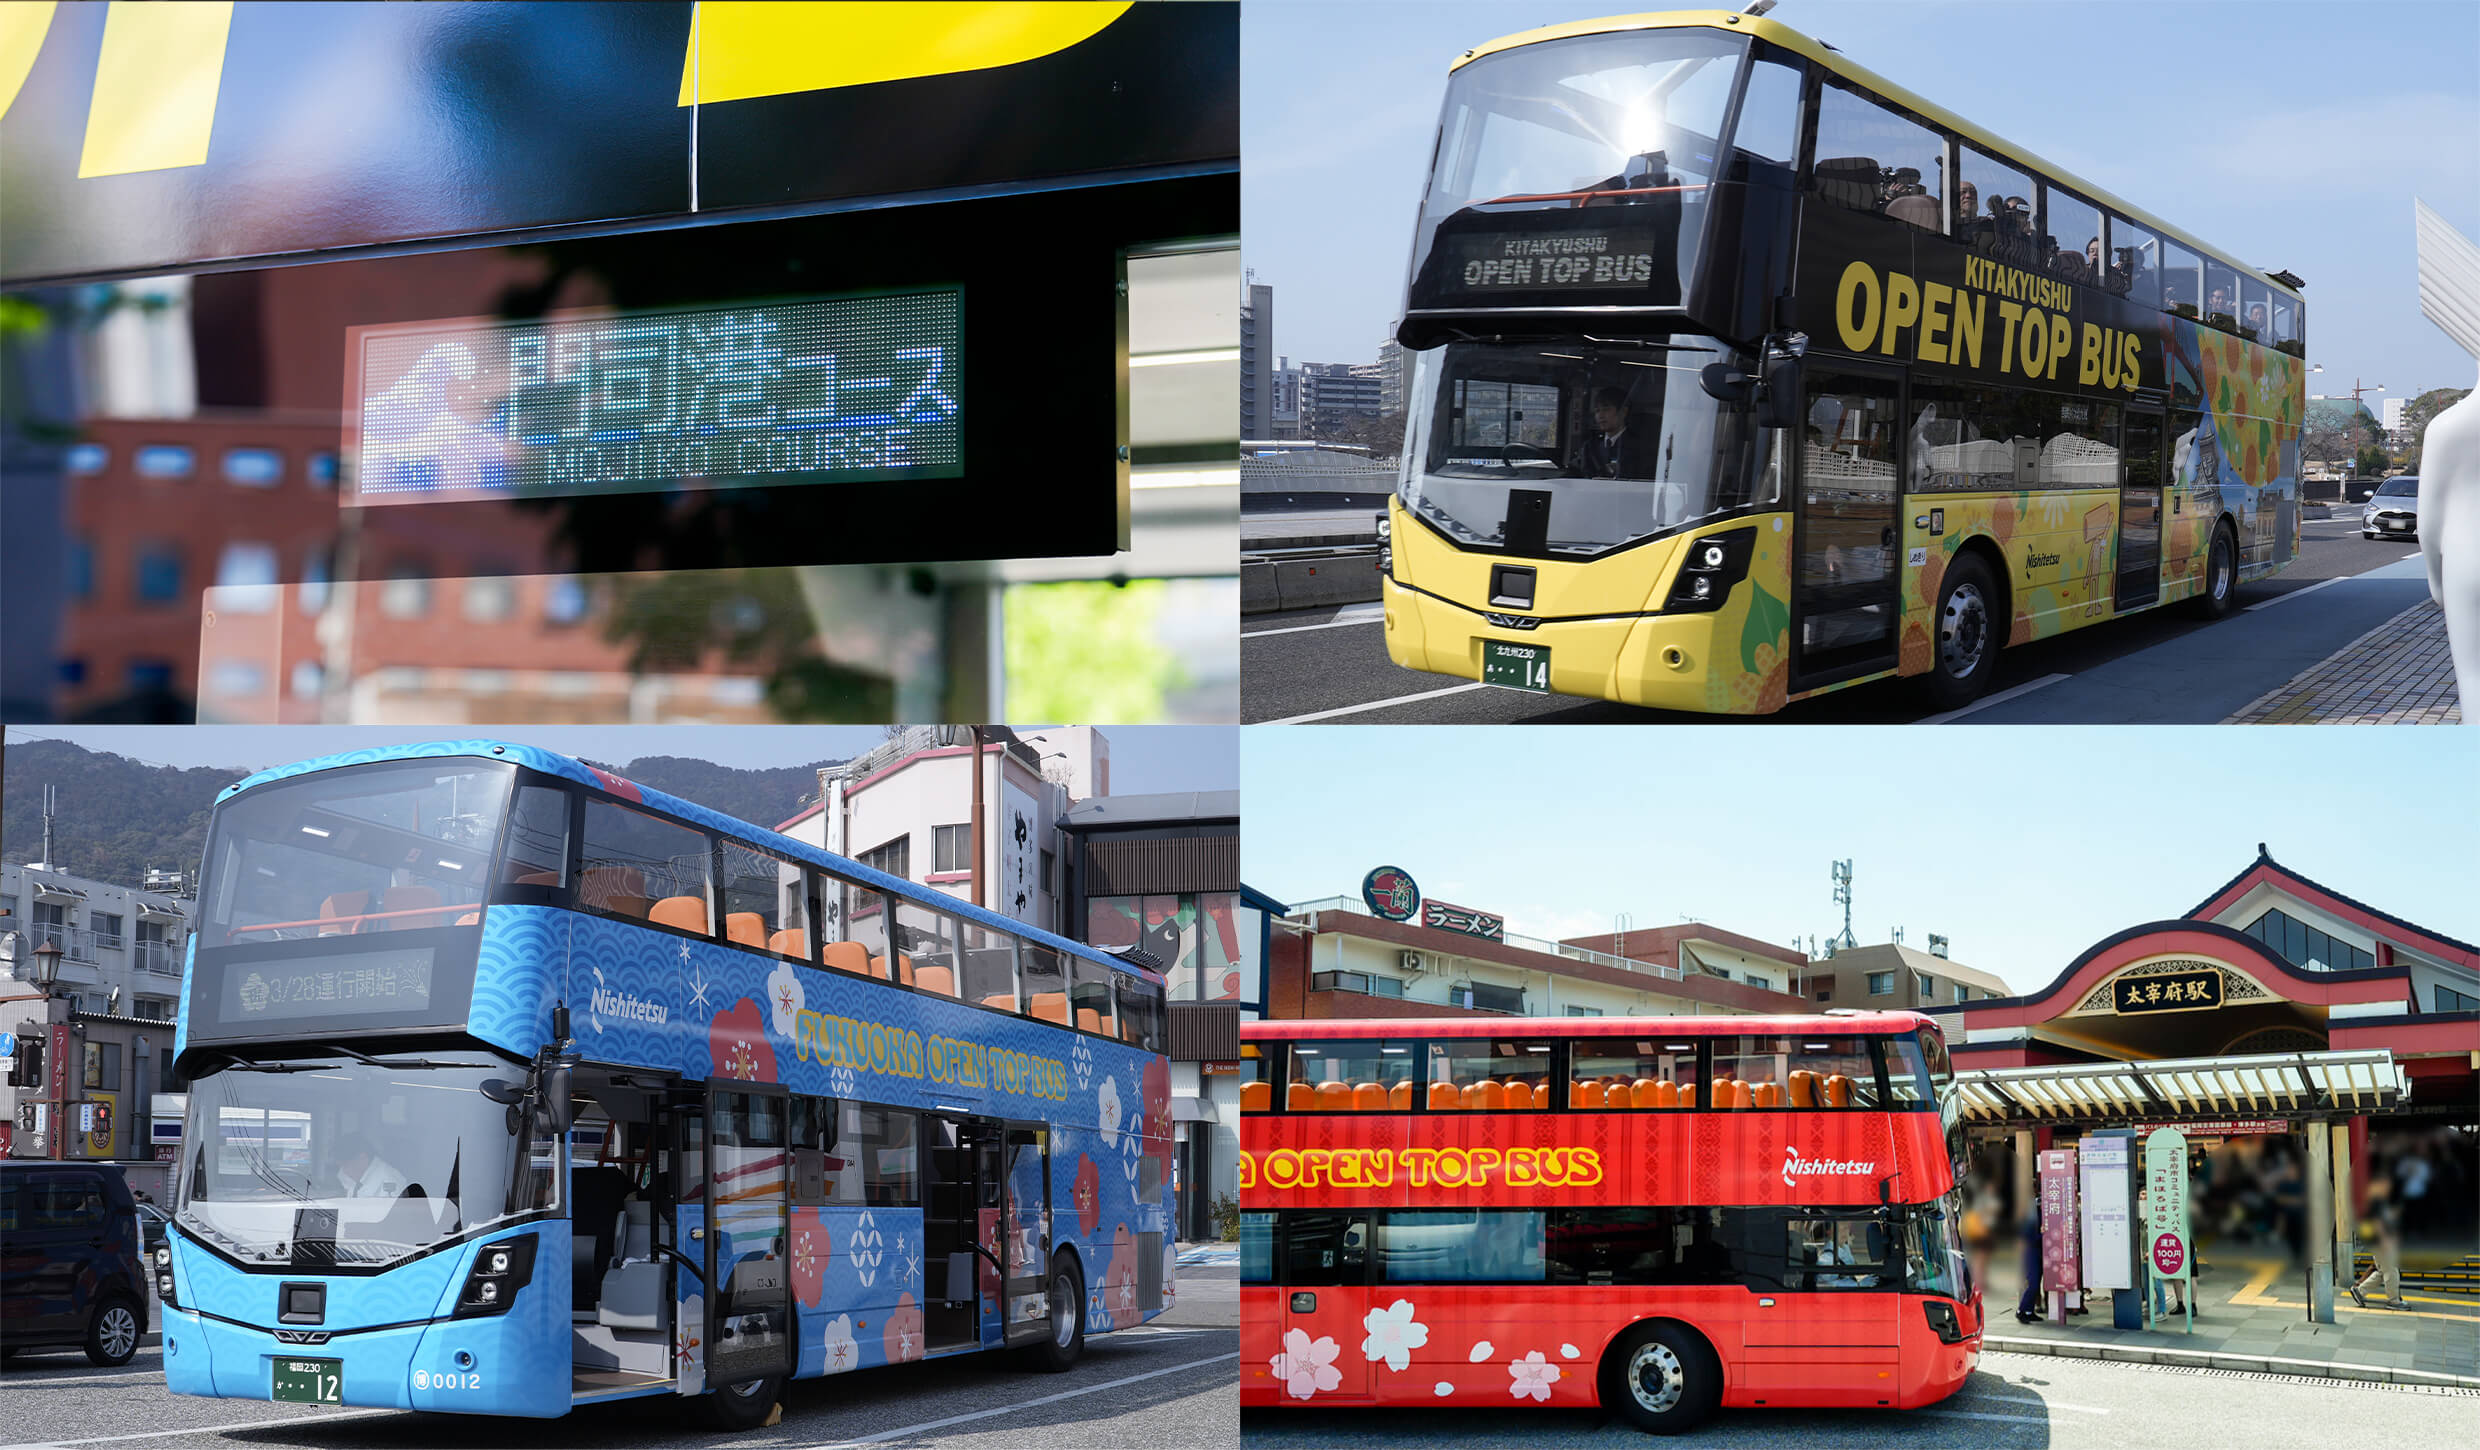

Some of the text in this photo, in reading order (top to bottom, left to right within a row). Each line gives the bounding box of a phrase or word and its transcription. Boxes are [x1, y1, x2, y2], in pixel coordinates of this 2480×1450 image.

[1504, 237, 1607, 257] KITAKYUSHU
[1464, 254, 1652, 285] OPEN TOP BUS
[1965, 254, 2071, 313] KITAKYUSHU
[1836, 261, 2142, 393] OPEN TOP BUS
[510, 312, 958, 441] 門司港コース
[547, 428, 912, 484] MOJIKO COURSE
[2025, 544, 2060, 580] Nishitetsu
[1427, 904, 1501, 937] ラーメン
[590, 966, 668, 1035] Nishitetsu
[2125, 980, 2212, 1005] 太宰府駅
[795, 1009, 1067, 1101] FUKUOKA OPEN TOP BUS
[1263, 1148, 1394, 1189] OPEN
[1399, 1147, 1502, 1188] TOP
[1505, 1147, 1603, 1187] BUS
[1782, 1146, 1875, 1187] Nishitetsu
[2048, 1176, 2061, 1214] 太宰府
